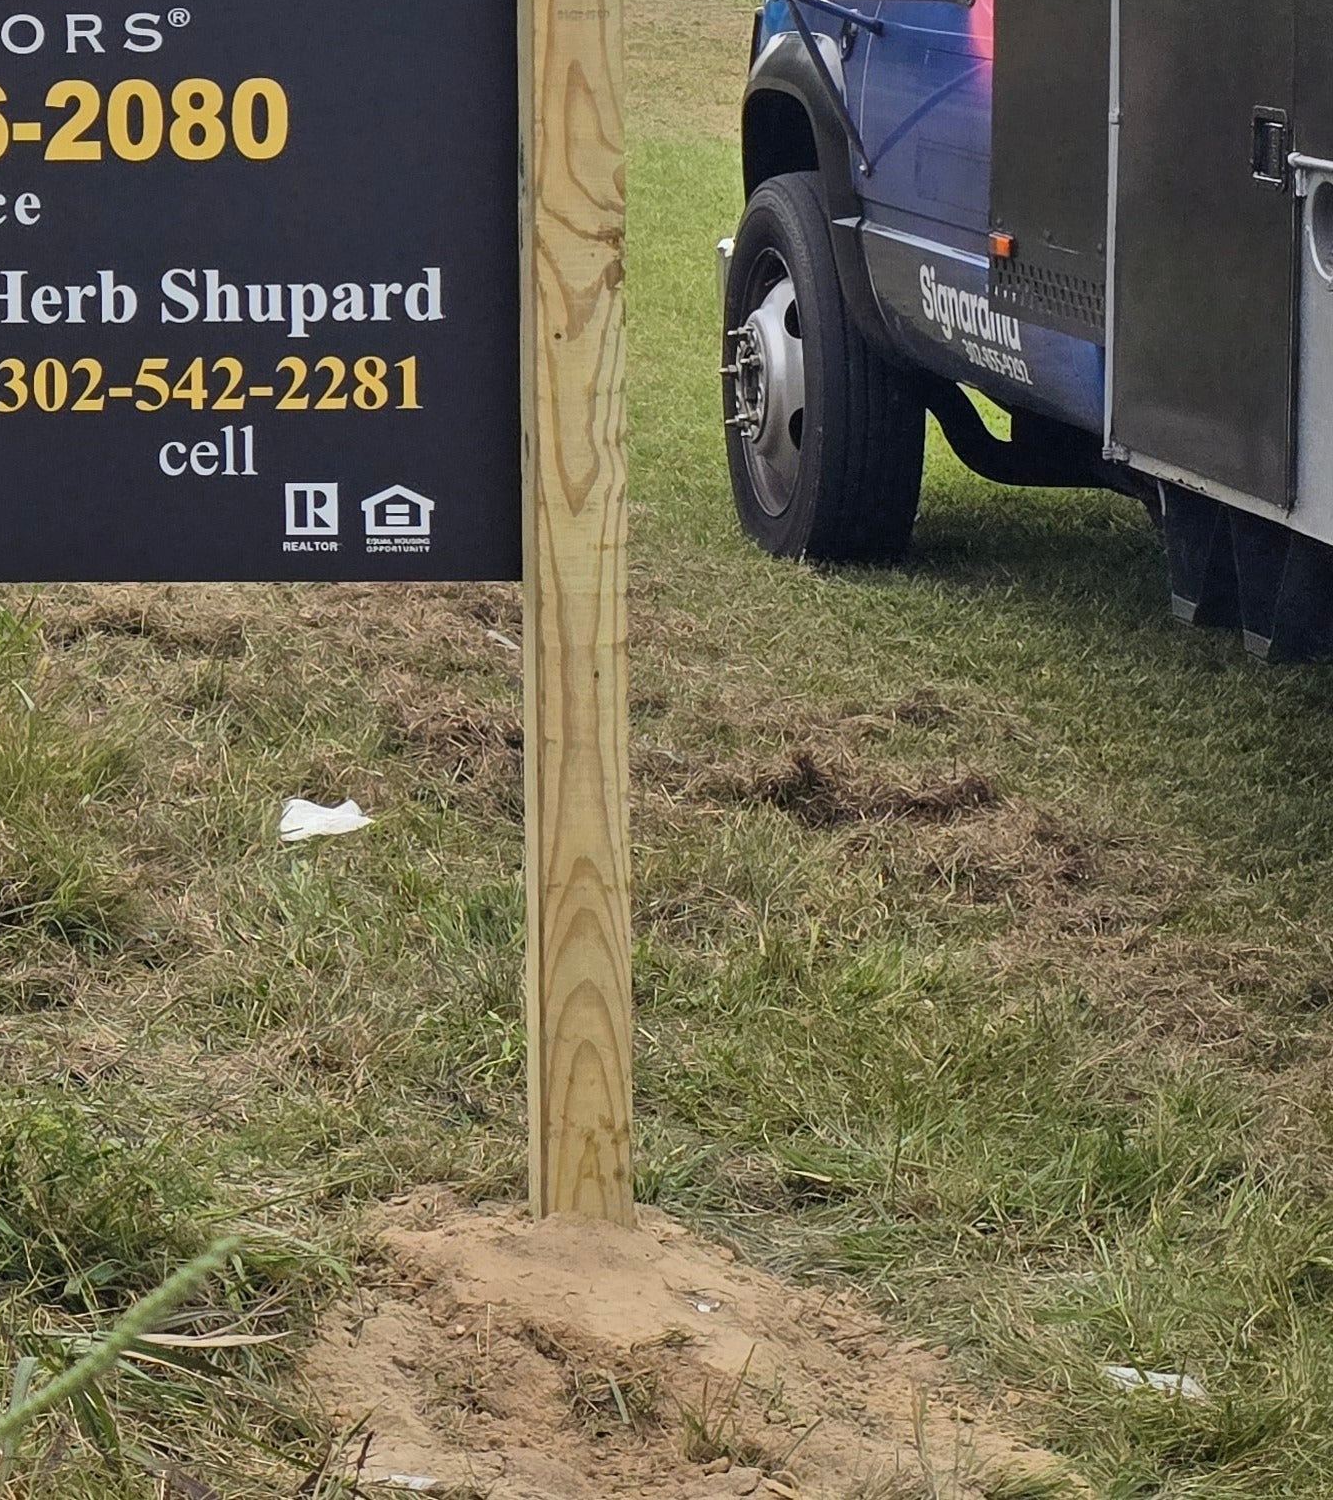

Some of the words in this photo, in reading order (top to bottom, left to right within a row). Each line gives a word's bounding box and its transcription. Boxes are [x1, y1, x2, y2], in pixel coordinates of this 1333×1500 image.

[160, 267, 444, 338] Shupard
[158, 424, 259, 477] cell
[283, 541, 339, 552] REALTOR
